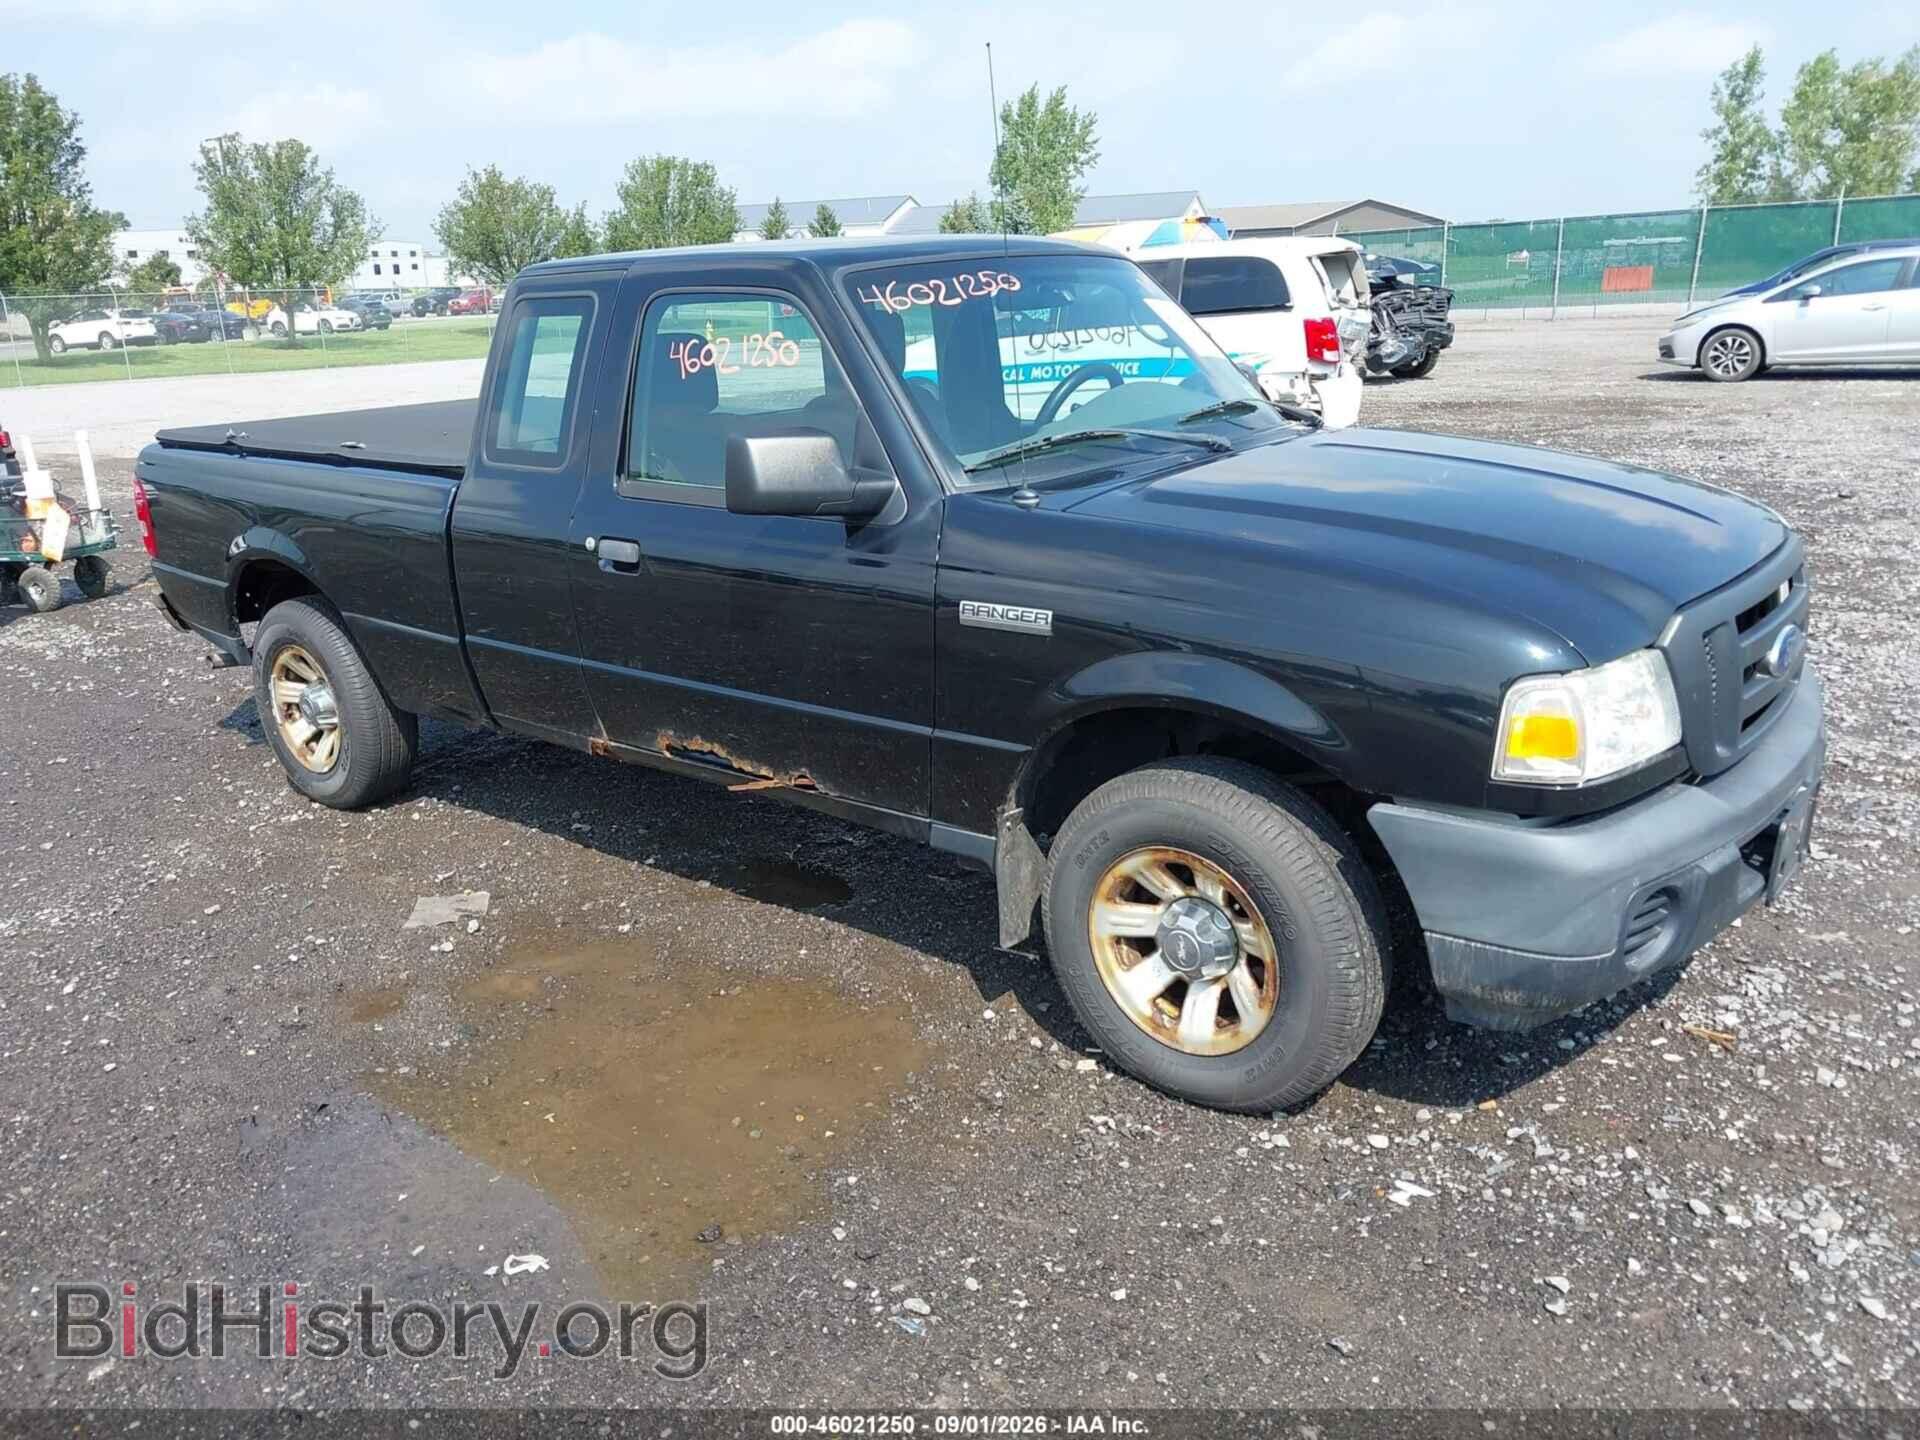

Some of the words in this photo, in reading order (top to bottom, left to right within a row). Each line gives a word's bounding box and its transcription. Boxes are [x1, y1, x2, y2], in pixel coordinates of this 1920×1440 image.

[857, 271, 1021, 314] 46021250
[670, 331, 800, 380] 46021250
[1002, 368, 1025, 381] CAL
[961, 603, 1049, 625] RANGER
